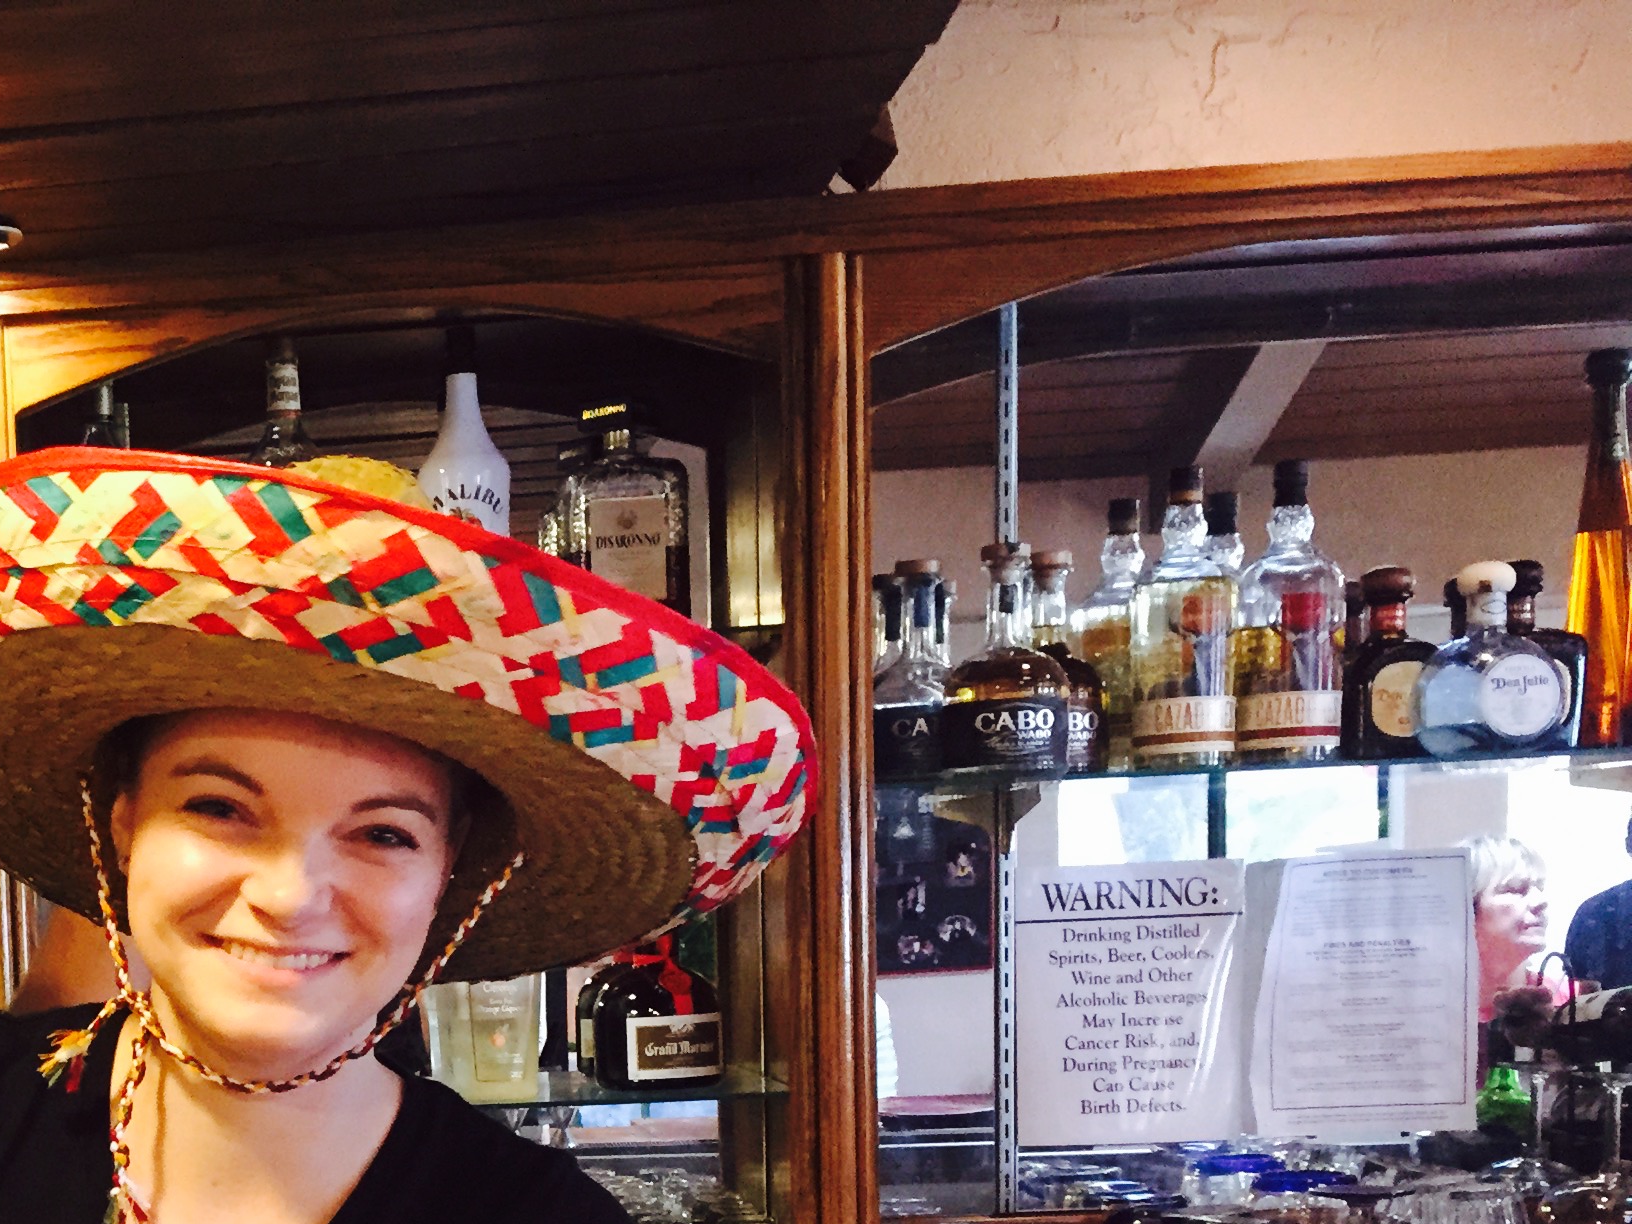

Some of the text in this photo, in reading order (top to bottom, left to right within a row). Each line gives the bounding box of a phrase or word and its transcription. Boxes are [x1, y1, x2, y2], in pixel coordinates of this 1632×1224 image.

[596, 532, 661, 550] DISARONNO
[974, 708, 1055, 734] CABO
[1041, 876, 1219, 912] WARNING:
[1062, 923, 1201, 943] Drinking Distilled
[1048, 950, 1102, 968] Spirits,
[1108, 948, 1146, 964] Beer,
[1071, 967, 1193, 985] Wine and Other
[1056, 992, 1128, 1008] Alcoholic
[1082, 1014, 1114, 1029] May
[644, 1041, 678, 1057] Grand
[1065, 1035, 1119, 1050] Cancer
[1125, 1034, 1164, 1049] Risk,
[1062, 1057, 1117, 1074] During
[1093, 1078, 1124, 1092] Can
[1081, 1099, 1121, 1115] Birth
